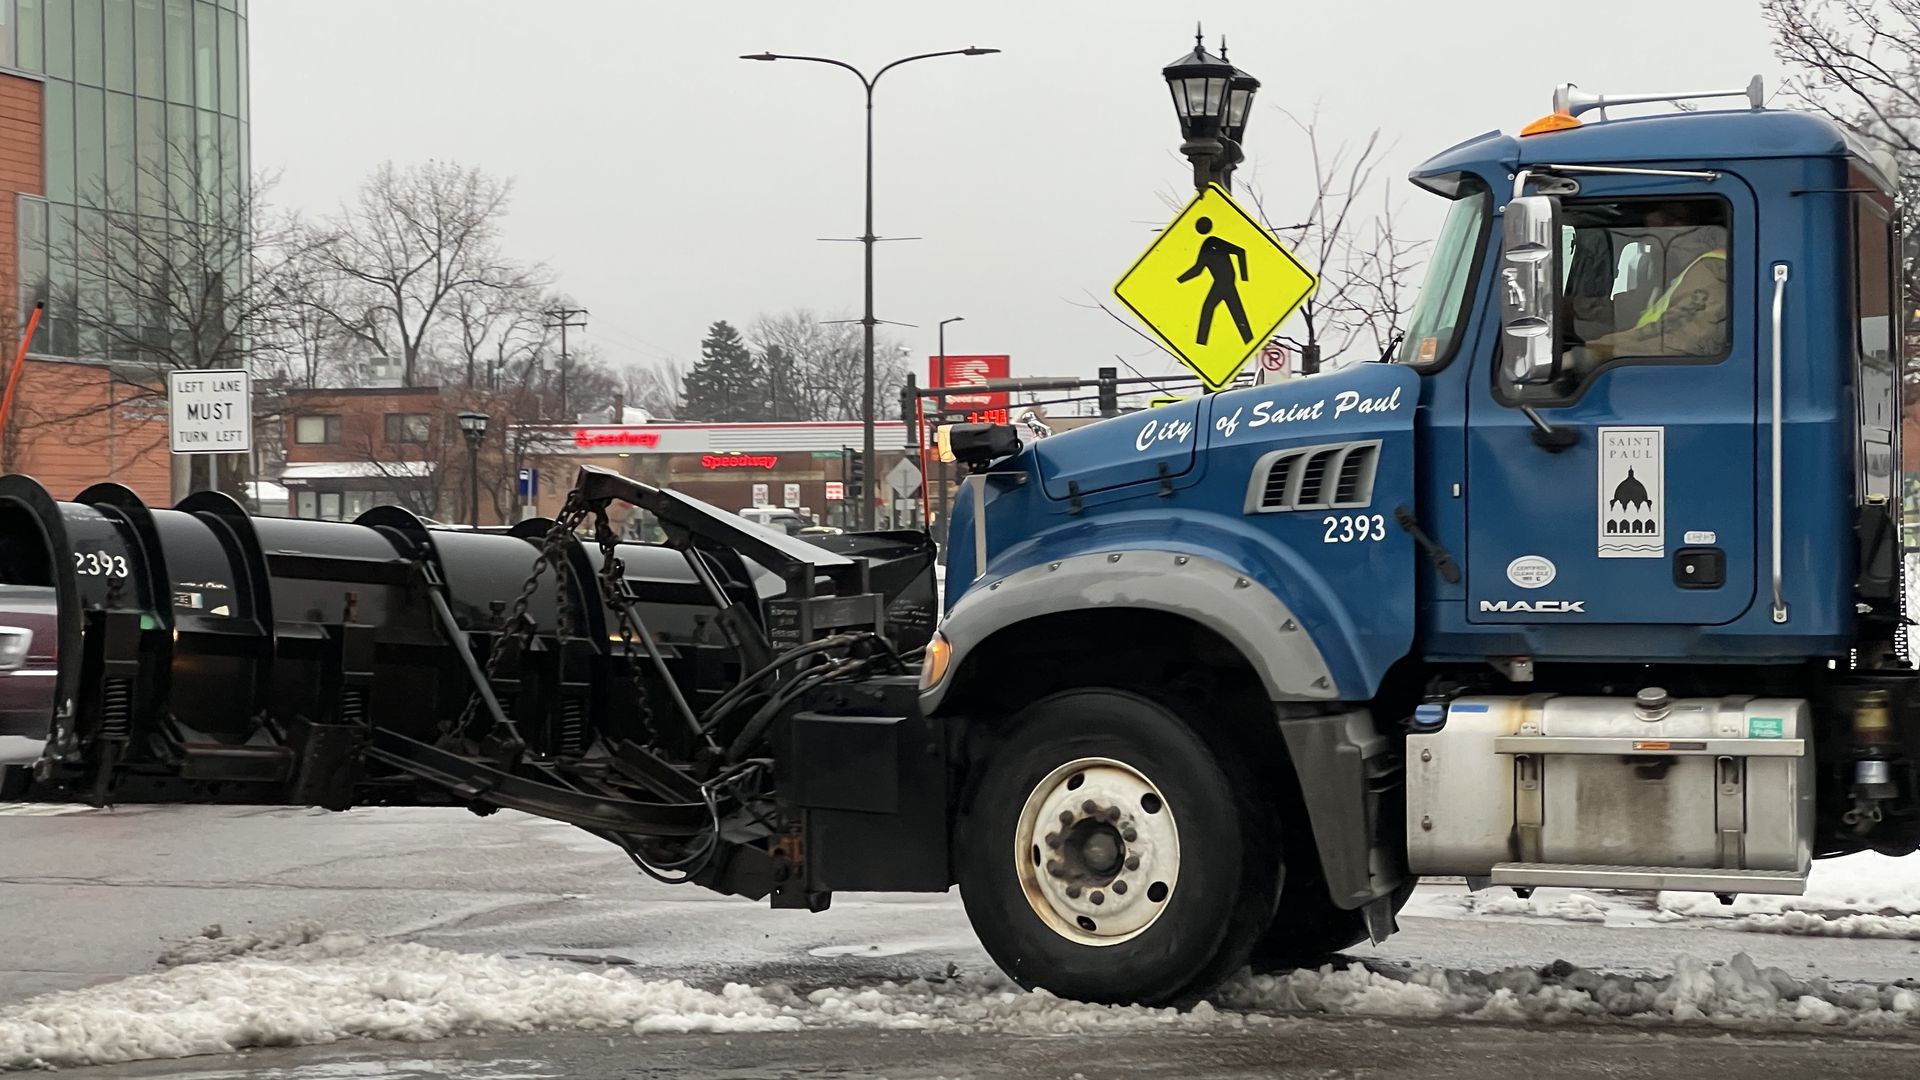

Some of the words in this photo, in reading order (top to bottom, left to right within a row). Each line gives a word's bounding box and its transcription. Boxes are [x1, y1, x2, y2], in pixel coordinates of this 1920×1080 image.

[178, 381, 204, 393] LEFT
[213, 380, 241, 392] LANE
[187, 402, 233, 420] MUST
[1135, 420, 1192, 452] City
[1216, 407, 1243, 438] of
[1248, 400, 1324, 428] Saint
[1333, 386, 1402, 420] Paul
[179, 431, 208, 442] TURN
[216, 430, 242, 442] LEFT
[1609, 437, 1653, 447] SAINT
[1609, 450, 1653, 459] PAUL
[702, 454, 778, 470] Speedway
[1323, 514, 1386, 543] 2393
[74, 550, 129, 578] 2393
[1480, 600, 1585, 613] MACK
